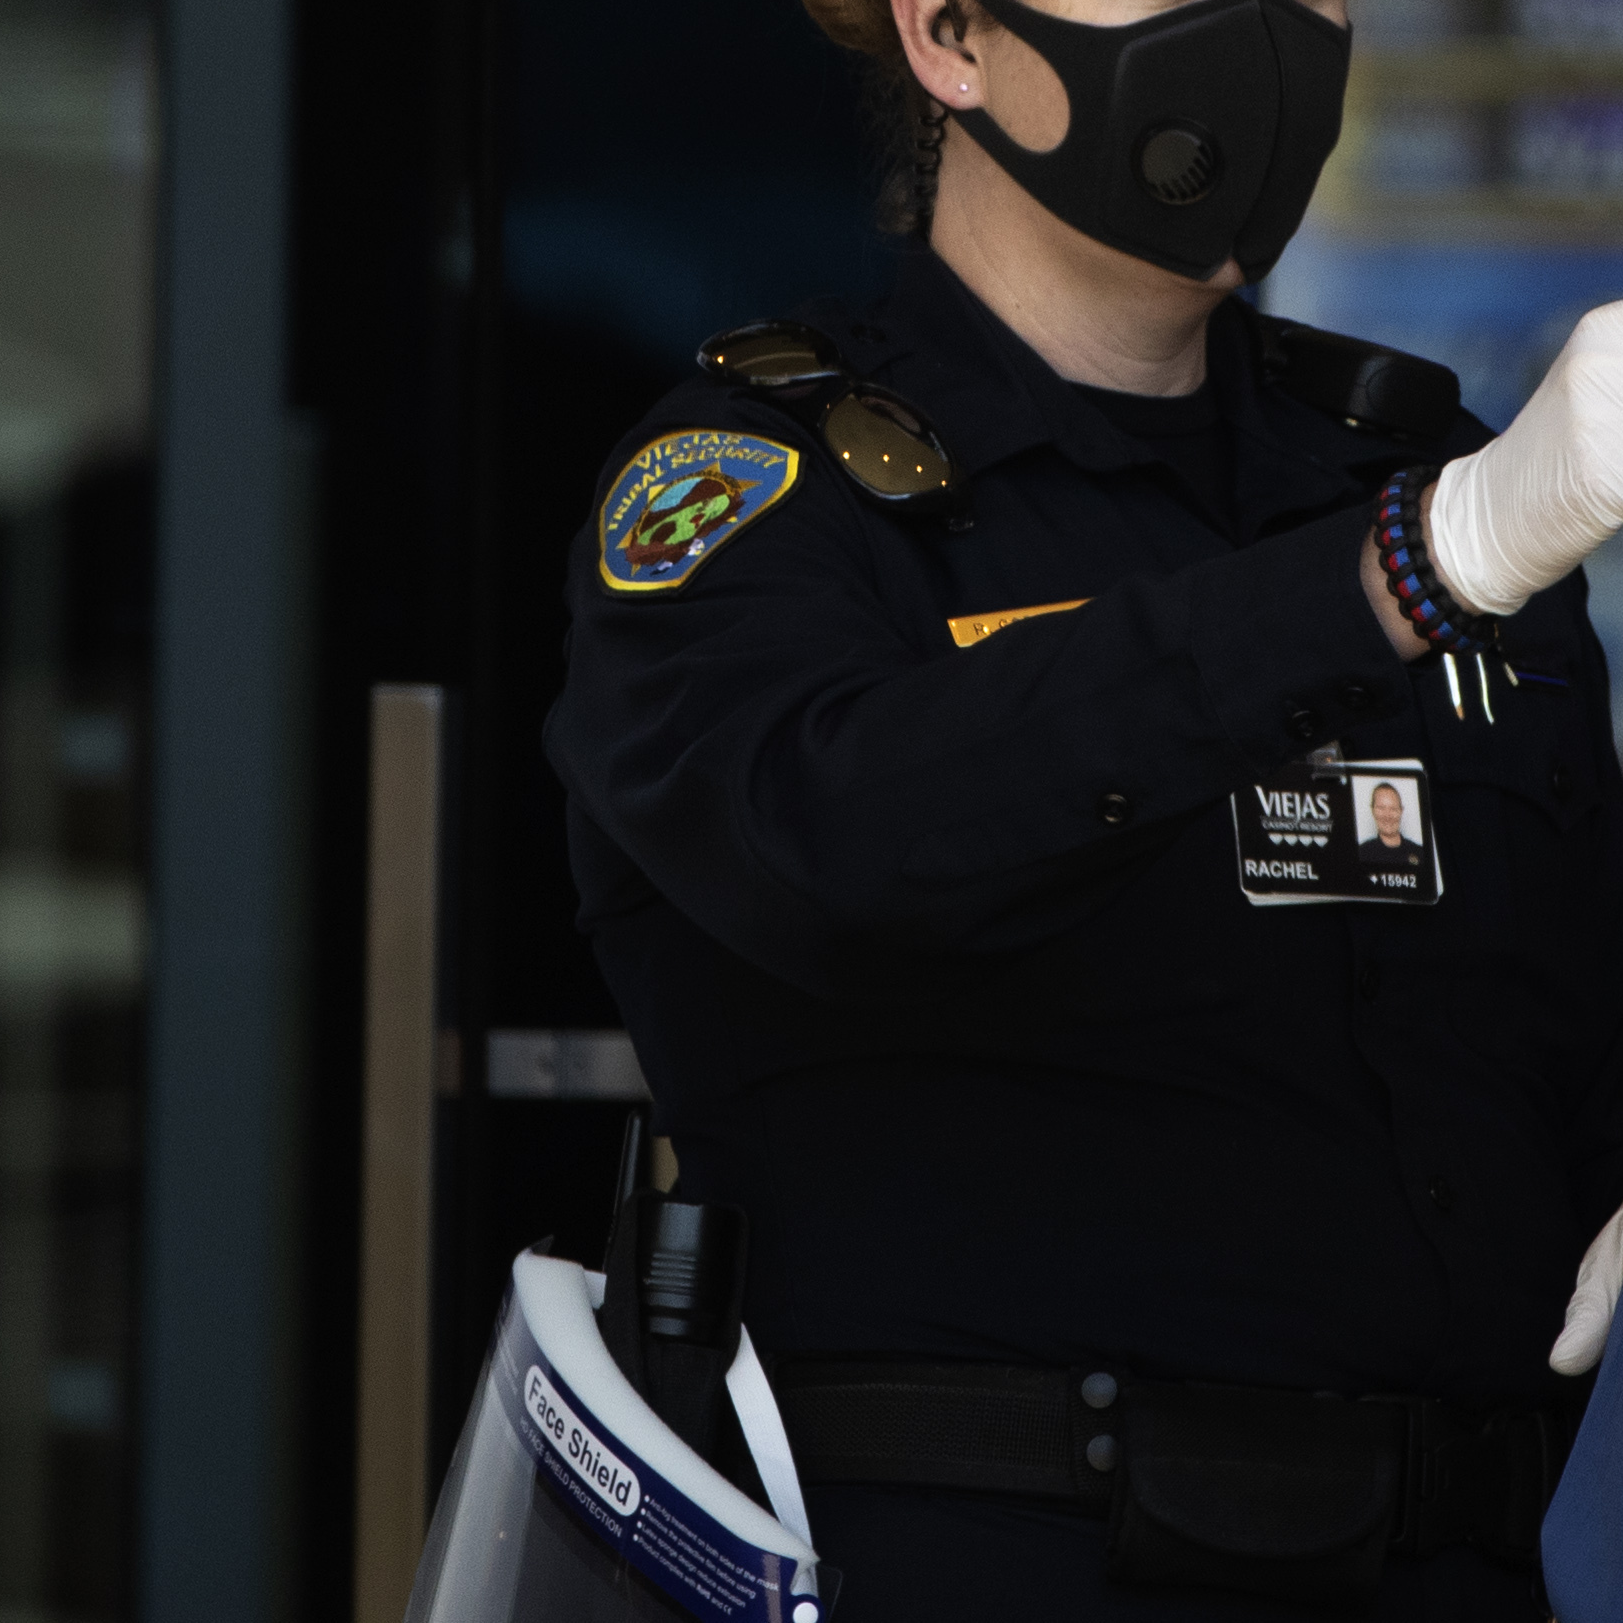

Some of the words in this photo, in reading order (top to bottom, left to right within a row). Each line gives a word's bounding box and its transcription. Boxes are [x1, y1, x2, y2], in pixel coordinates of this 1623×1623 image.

[1254, 784, 1331, 821] VIEJAS
[1244, 859, 1319, 880] RACHEL
[528, 1375, 566, 1441] Face
[567, 1427, 633, 1507] Shield
[540, 1451, 570, 1486] SHIELD
[565, 1479, 623, 1538] PROTECTION
[668, 1529, 679, 1542] the
[735, 1583, 757, 1600] using
[671, 1516, 698, 1541] treatment
[743, 1570, 757, 1583] the
[757, 1578, 779, 1592] mask
[716, 1585, 746, 1608] extrusion
